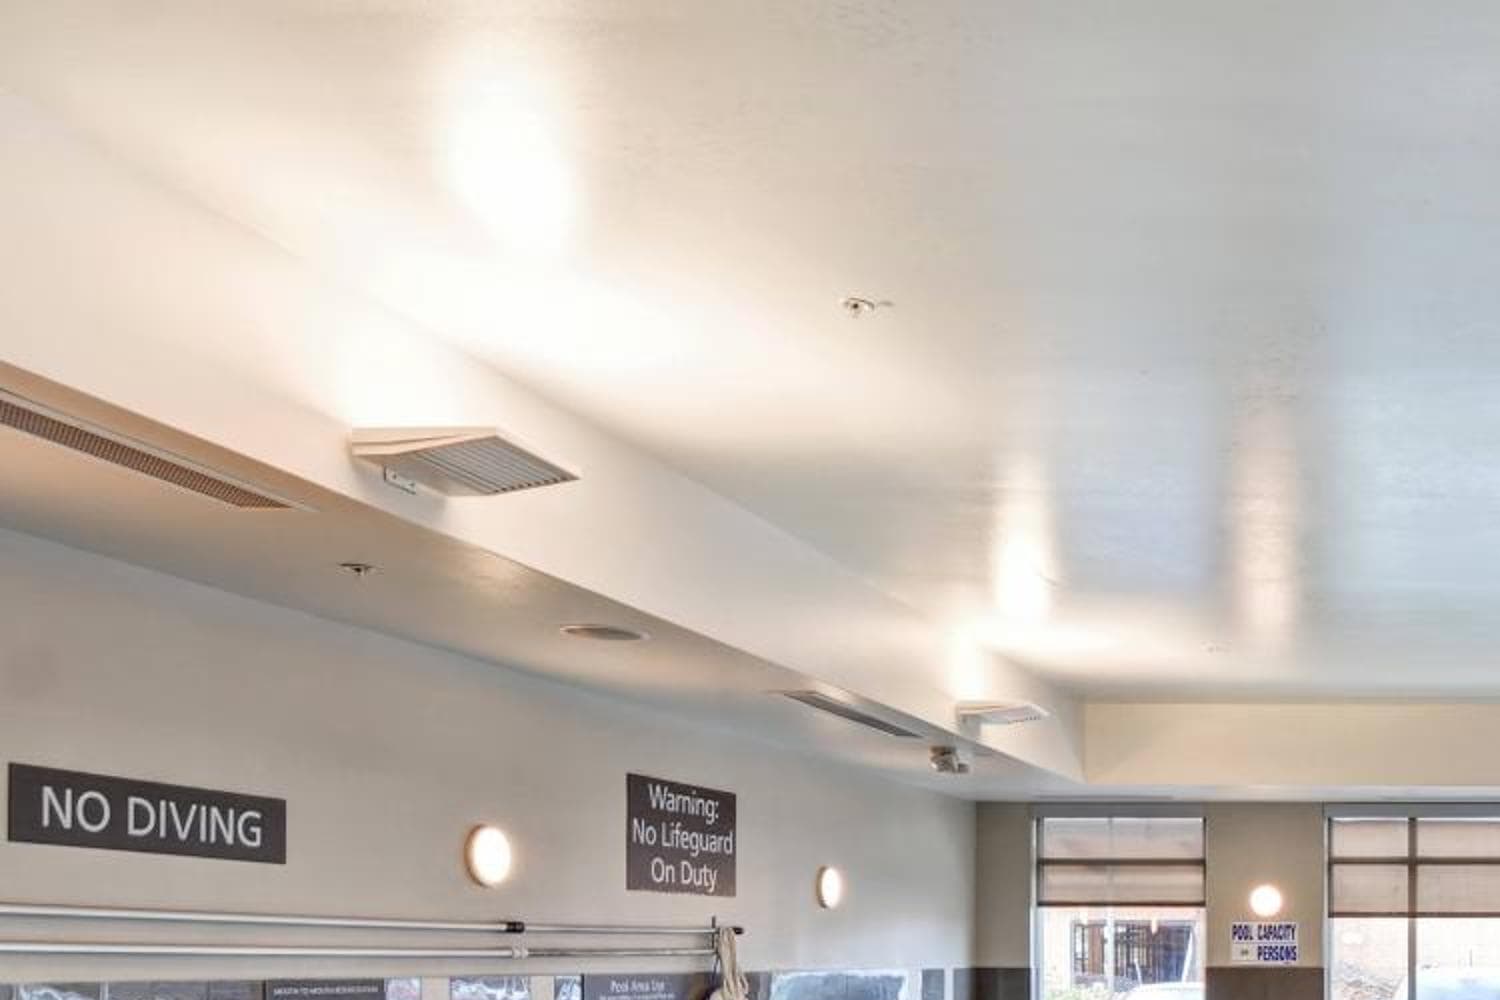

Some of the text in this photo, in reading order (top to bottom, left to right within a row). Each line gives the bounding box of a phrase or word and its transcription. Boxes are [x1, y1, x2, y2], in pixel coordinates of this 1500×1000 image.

[42, 786, 262, 848] NO DIVING
[648, 783, 719, 825] Warning:
[632, 817, 733, 857] No Lifeguard
[651, 857, 718, 893] On Duty
[1233, 924, 1297, 940] POOL CAPACITY
[1257, 945, 1297, 961] PERSONS
